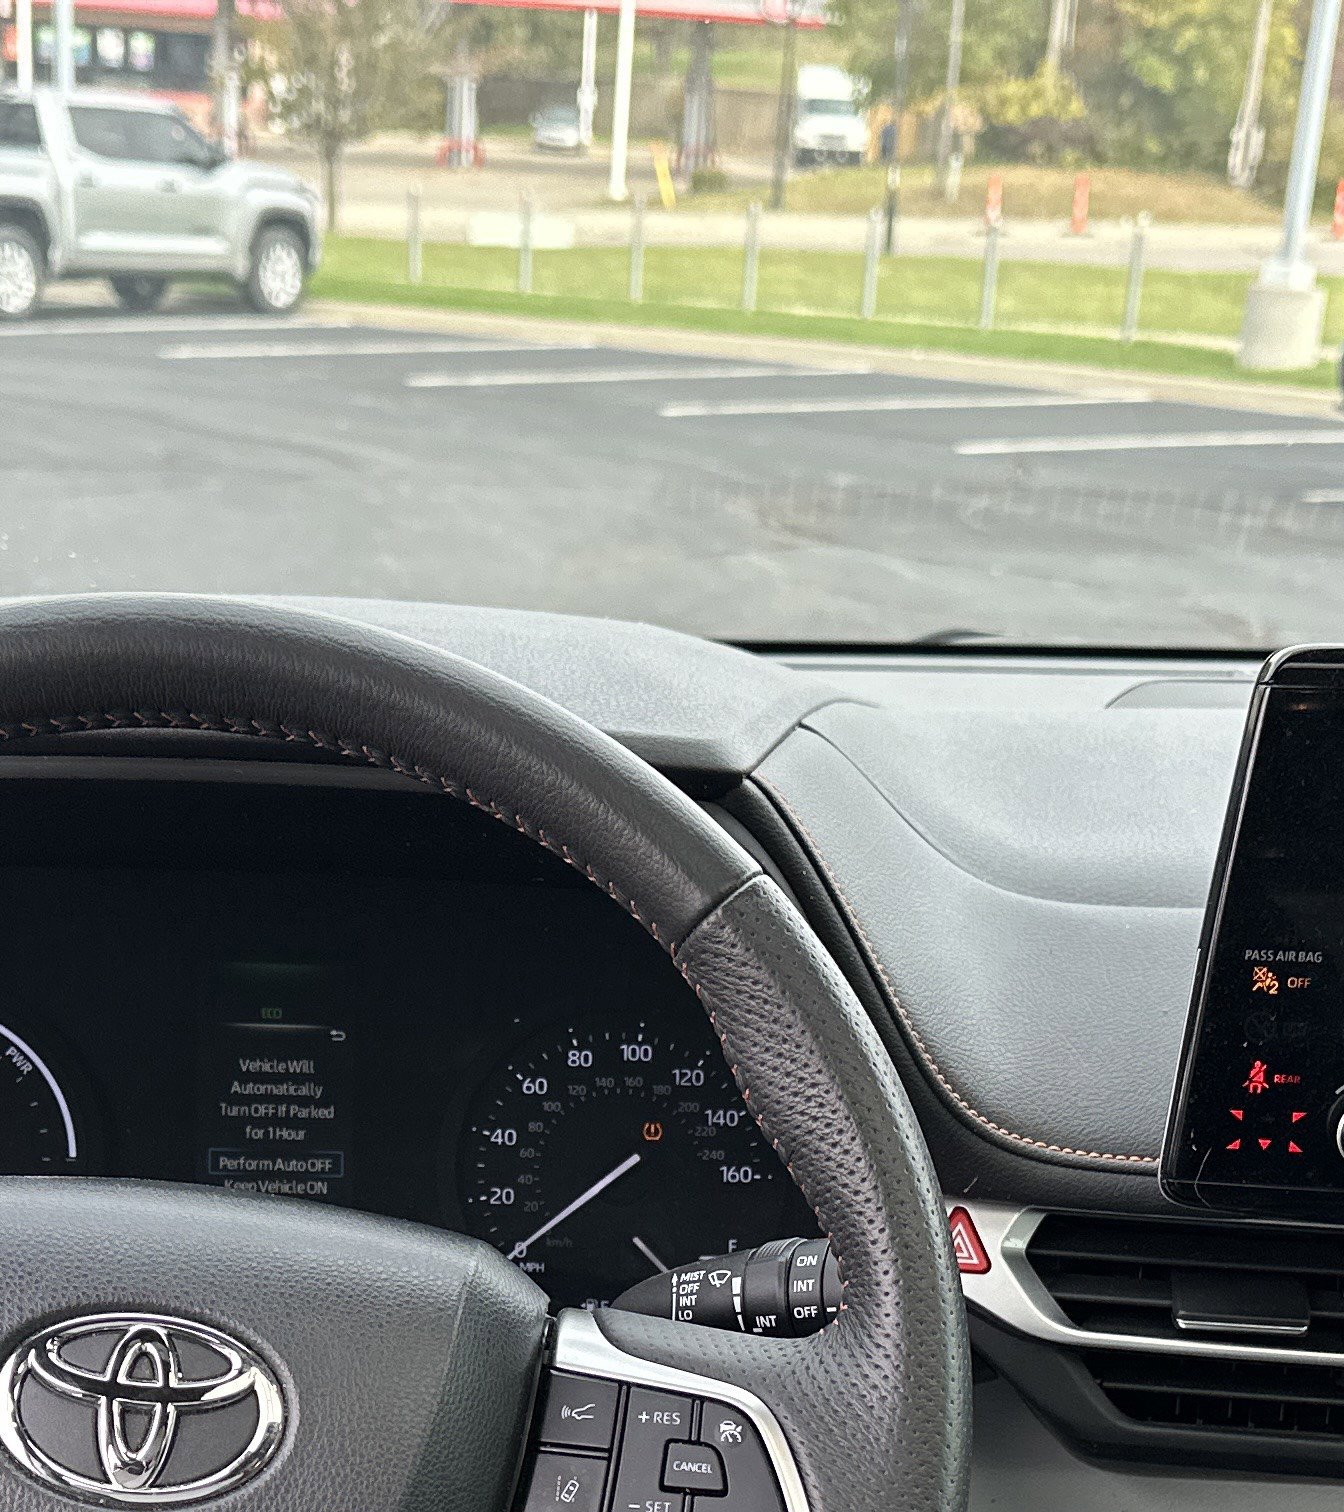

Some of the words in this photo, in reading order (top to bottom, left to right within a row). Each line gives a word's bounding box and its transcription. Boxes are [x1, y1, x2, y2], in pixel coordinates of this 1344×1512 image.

[1245, 949, 1274, 962] PASS
[1275, 950, 1297, 962] AIR
[1298, 951, 1323, 964] BAG
[1287, 976, 1312, 989] OFF
[5, 1046, 33, 1075] PWR
[567, 1050, 593, 1067] 80
[620, 1045, 653, 1062] 100
[239, 1058, 287, 1074] Vehicle
[288, 1059, 315, 1074] Will
[595, 1077, 615, 1088] 140
[624, 1076, 644, 1087] 160
[672, 1069, 705, 1087] 120
[1273, 1074, 1302, 1085] REAR
[231, 1080, 323, 1100] Automatically
[522, 1078, 548, 1095] 60
[220, 1103, 249, 1118] Turn
[251, 1103, 275, 1118] OFF
[277, 1104, 288, 1118] If
[289, 1104, 335, 1119] Parked
[705, 1109, 739, 1127] 140
[245, 1125, 265, 1140] for
[275, 1127, 307, 1141] Hour
[490, 1128, 517, 1146] 40
[219, 1155, 273, 1171] Perform
[274, 1157, 306, 1172] Auto
[307, 1158, 333, 1172] OFF
[720, 1165, 753, 1183] 160
[257, 1180, 306, 1195] Vehicle
[306, 1181, 328, 1195] ON
[489, 1187, 515, 1205] 20
[519, 1262, 545, 1274] MPH
[796, 1255, 818, 1267] ON
[680, 1270, 706, 1283] MIST
[679, 1283, 700, 1295] OFF
[793, 1279, 816, 1293] INT
[679, 1295, 698, 1307] INT
[679, 1309, 693, 1321] LO
[793, 1305, 818, 1319] OFF
[756, 1315, 777, 1328] INT
[653, 1411, 681, 1425] RES
[673, 1460, 713, 1474] CANCEL
